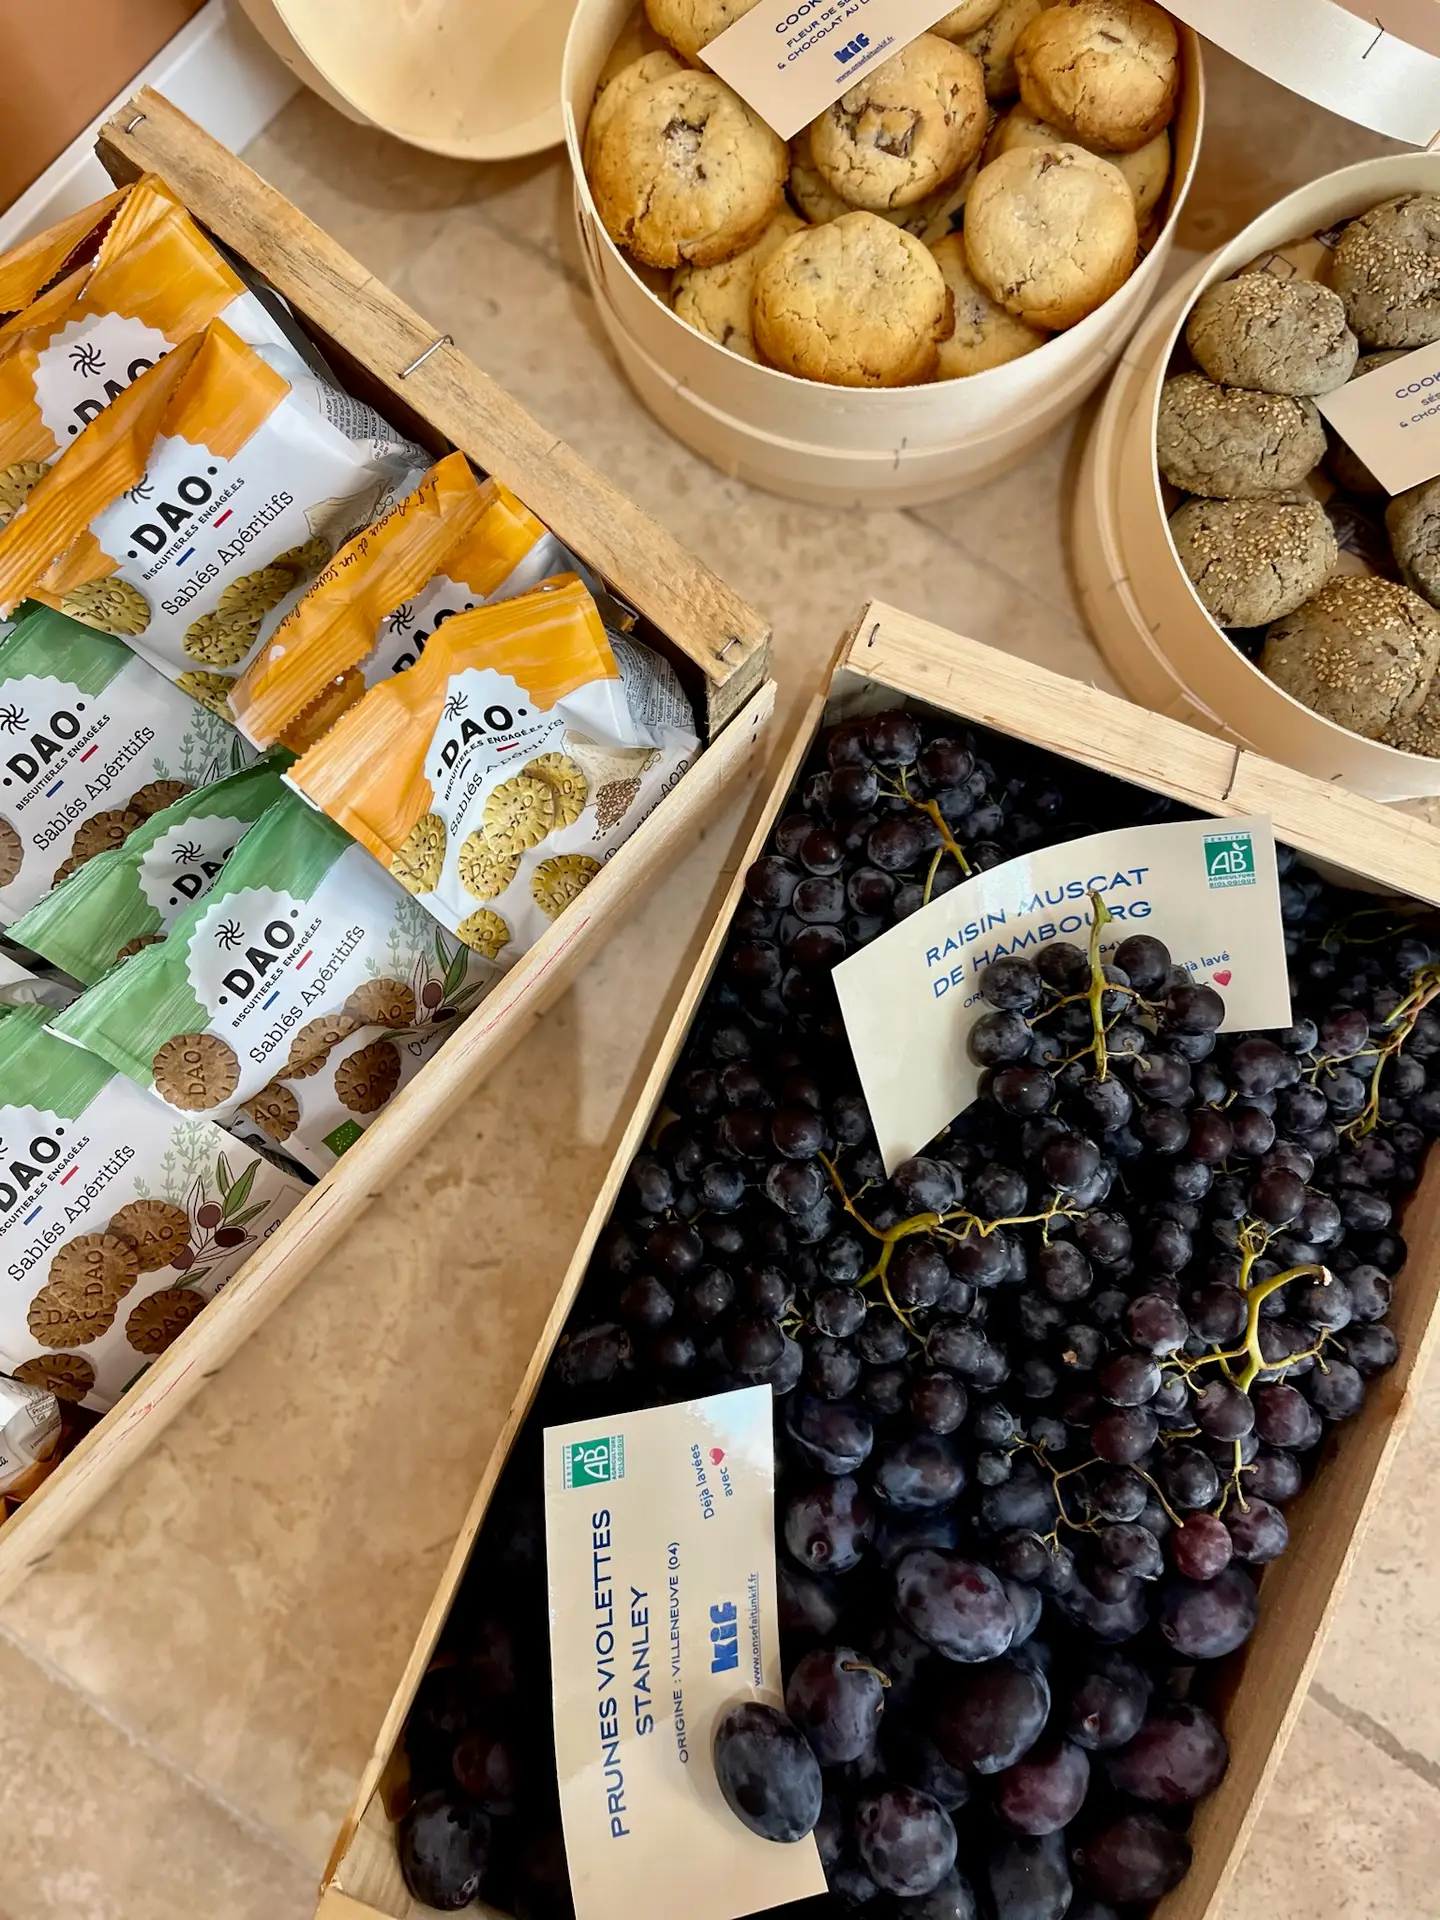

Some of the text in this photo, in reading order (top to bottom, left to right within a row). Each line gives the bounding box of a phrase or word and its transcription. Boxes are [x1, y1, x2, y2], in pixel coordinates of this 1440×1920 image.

[787, 20, 820, 47] FLEUR
[821, 7, 837, 20] DE
[788, 15, 843, 61] CHOCOLAT
[846, 4, 859, 17] AU
[130, 476, 212, 555] DAO
[161, 491, 294, 616] Sablés Apéritifs
[6, 711, 81, 783] DAO
[441, 705, 513, 769] DAO
[33, 726, 155, 850] Sablés Apéritifs
[450, 773, 483, 837] Sablés
[1211, 851, 1247, 875] AB
[223, 920, 295, 999] DAO
[926, 908, 1006, 967] RAISIN
[1201, 951, 1230, 968] lavé
[250, 924, 365, 1064] Sablés Apéritifs
[933, 965, 965, 998] DE
[8, 1145, 135, 1281] Sablés Apéritifs
[584, 1445, 609, 1478] AB
[691, 1444, 714, 1520] Déjà lavées
[720, 1467, 733, 1497] avec
[668, 1541, 681, 1571] (04)
[630, 1586, 654, 1735] STANLEY
[670, 1575, 682, 1677] VILLENEUVE
[748, 1572, 763, 1686] www.onsefaitunkif.fr
[592, 1509, 630, 1839] PRUNES VIOLETTES
[674, 1689, 689, 1764] ORIGINE
